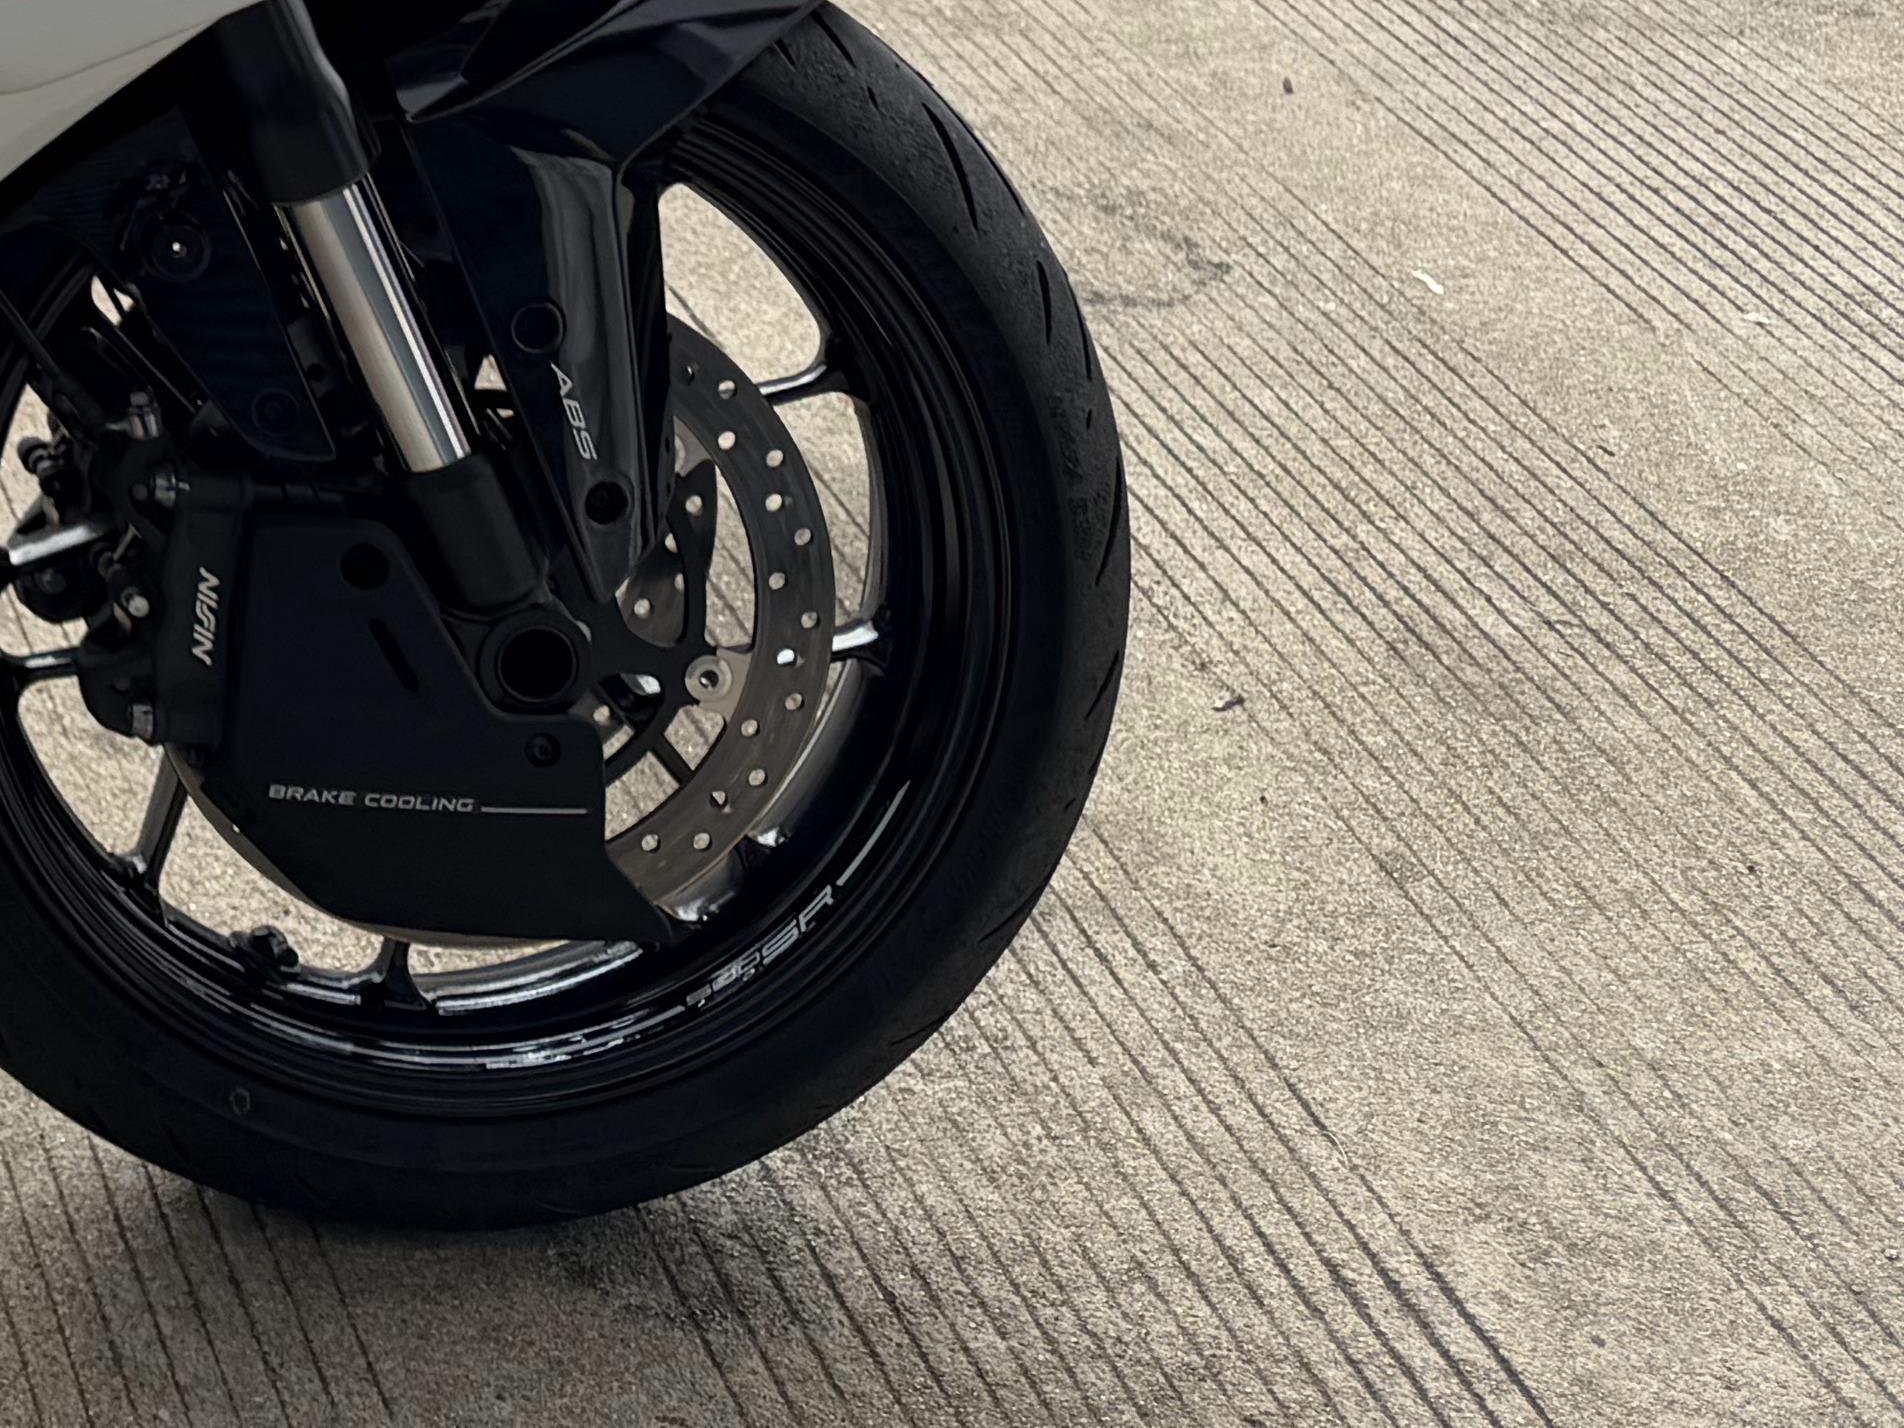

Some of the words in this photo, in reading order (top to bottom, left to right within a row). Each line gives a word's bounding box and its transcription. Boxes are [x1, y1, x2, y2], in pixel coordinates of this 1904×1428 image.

[548, 359, 599, 462] ABS
[267, 782, 357, 806] BRAKE
[363, 792, 475, 814] COOLING
